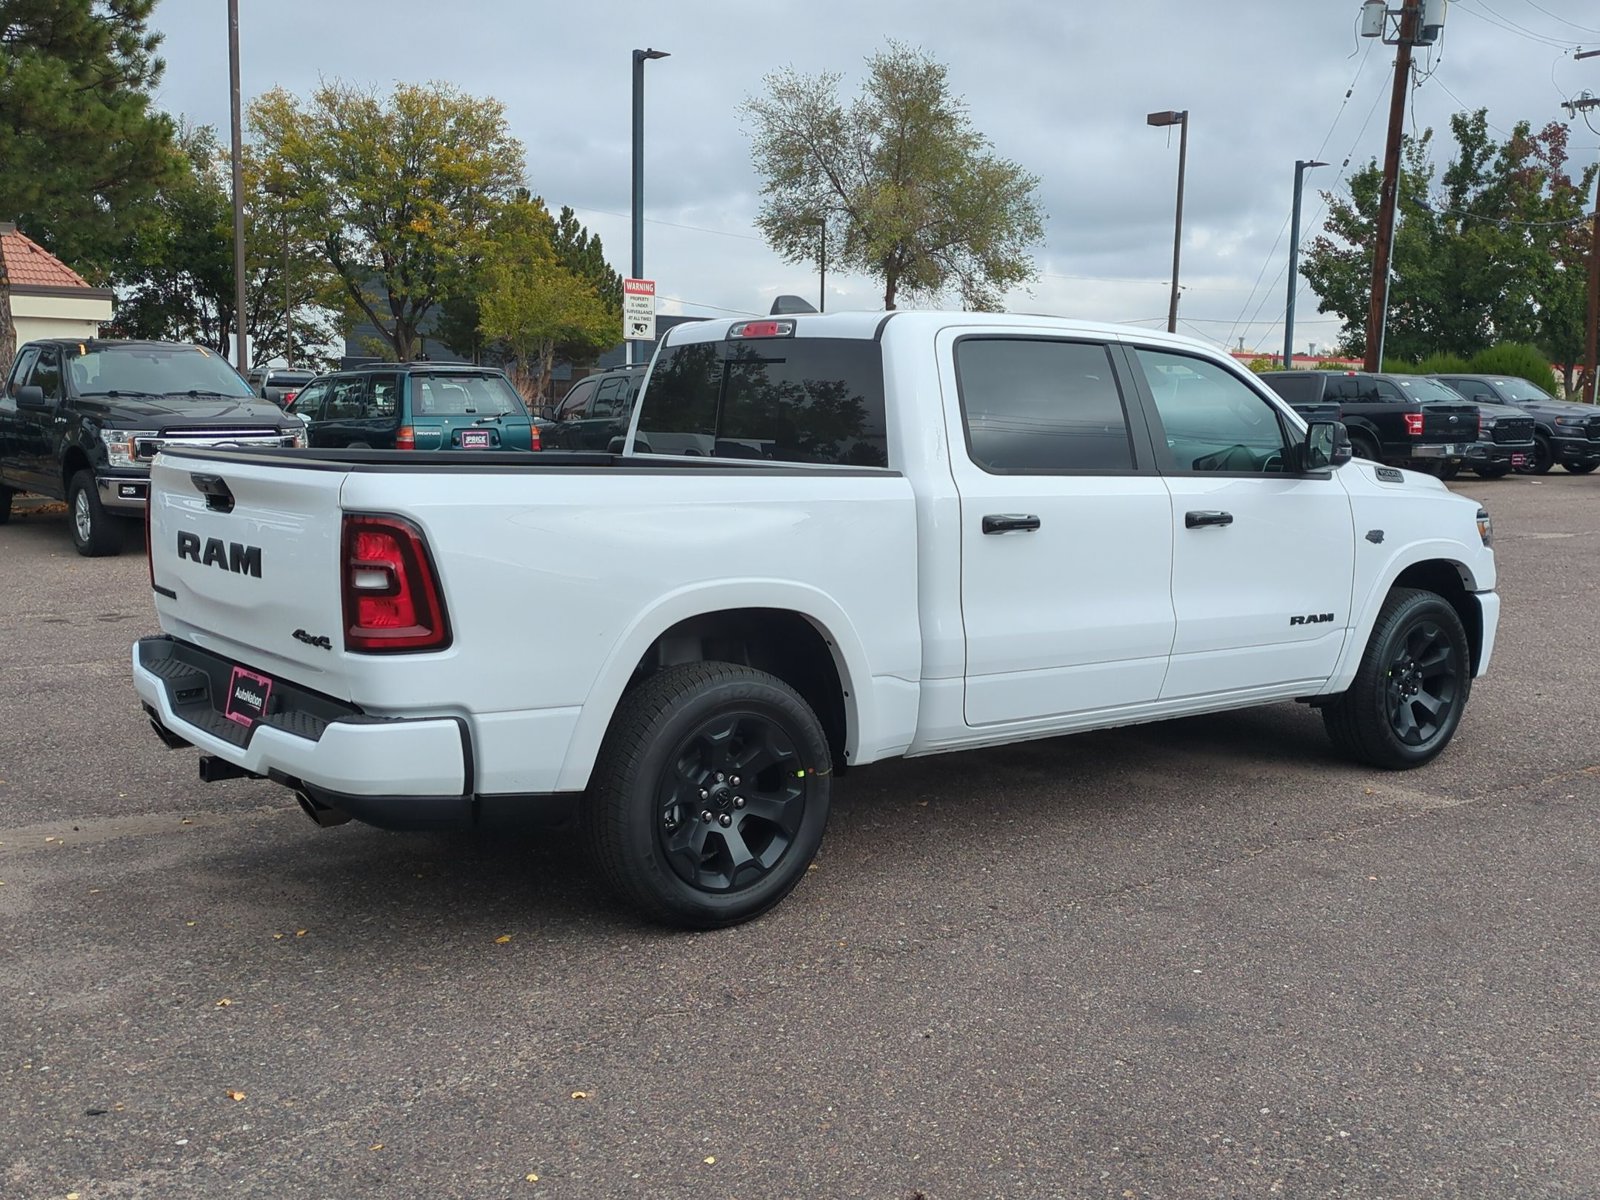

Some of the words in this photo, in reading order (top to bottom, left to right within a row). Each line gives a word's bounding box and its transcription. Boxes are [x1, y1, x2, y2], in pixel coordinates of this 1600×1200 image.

[626, 281, 654, 293] WARNING
[177, 530, 262, 578] RAM
[1290, 613, 1334, 626] RAM
[234, 686, 263, 708] AutoNation
